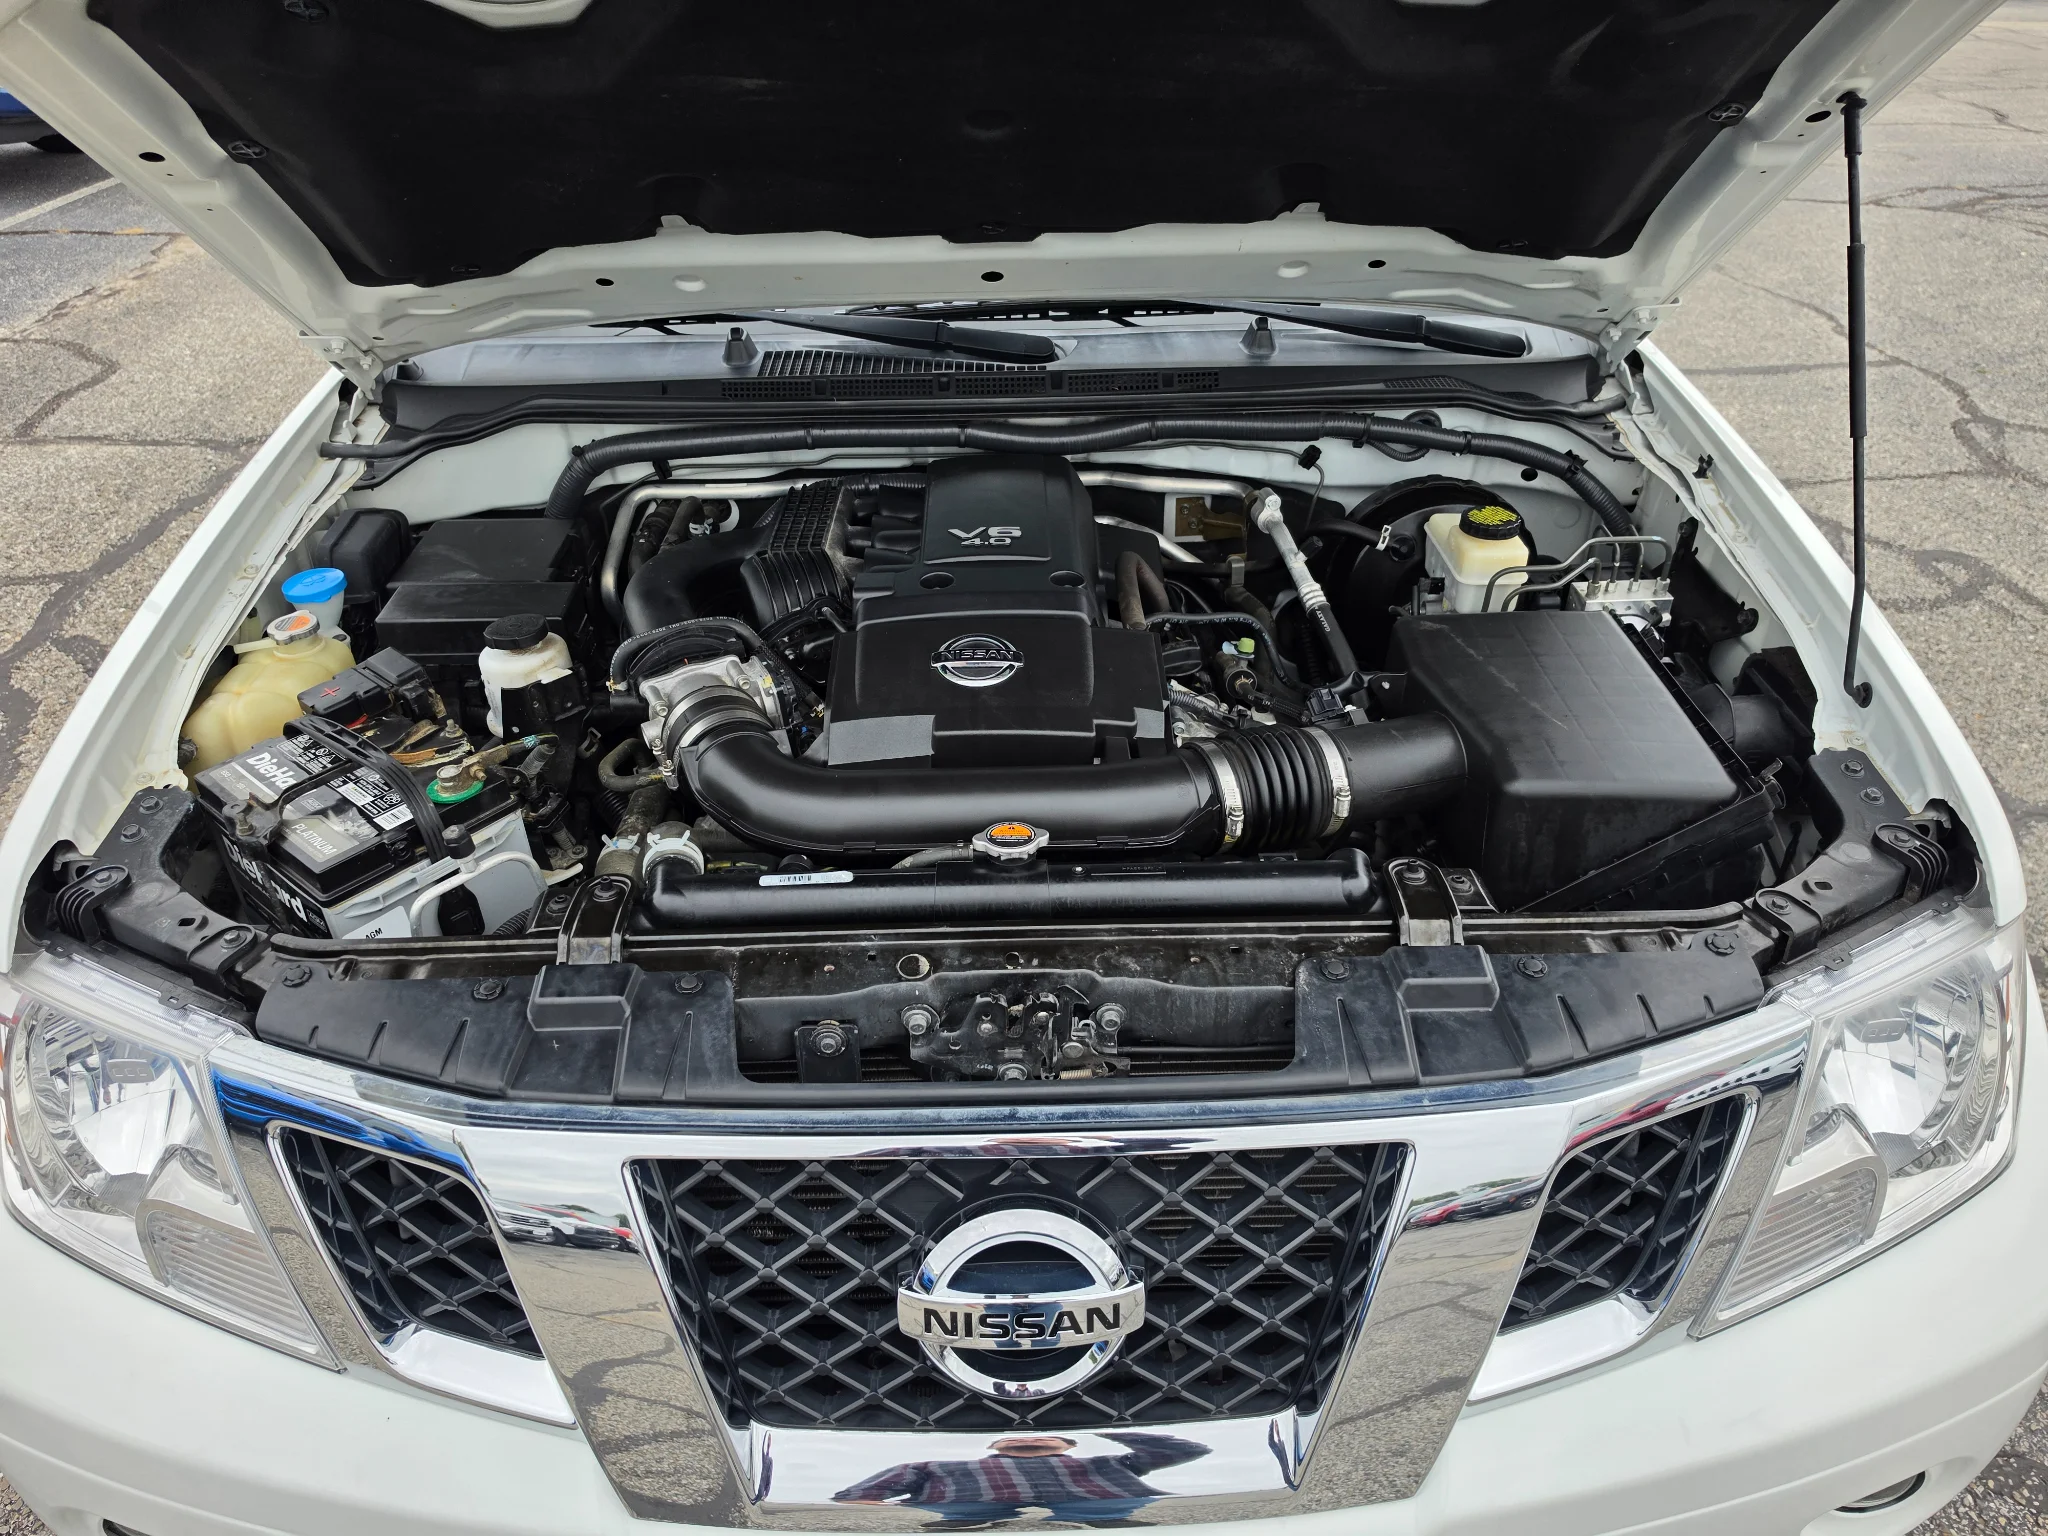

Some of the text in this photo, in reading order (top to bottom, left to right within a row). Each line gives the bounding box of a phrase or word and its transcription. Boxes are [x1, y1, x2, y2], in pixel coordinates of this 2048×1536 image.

[947, 526, 1022, 539] V6
[960, 537, 1012, 546] 4.0
[1315, 610, 1331, 632] GALAXY
[940, 649, 1014, 660] NISSAN
[245, 752, 298, 790] DieHa
[291, 823, 338, 855] PLATINUM
[365, 927, 383, 939] AGM
[923, 1302, 1121, 1340] NISSAN
